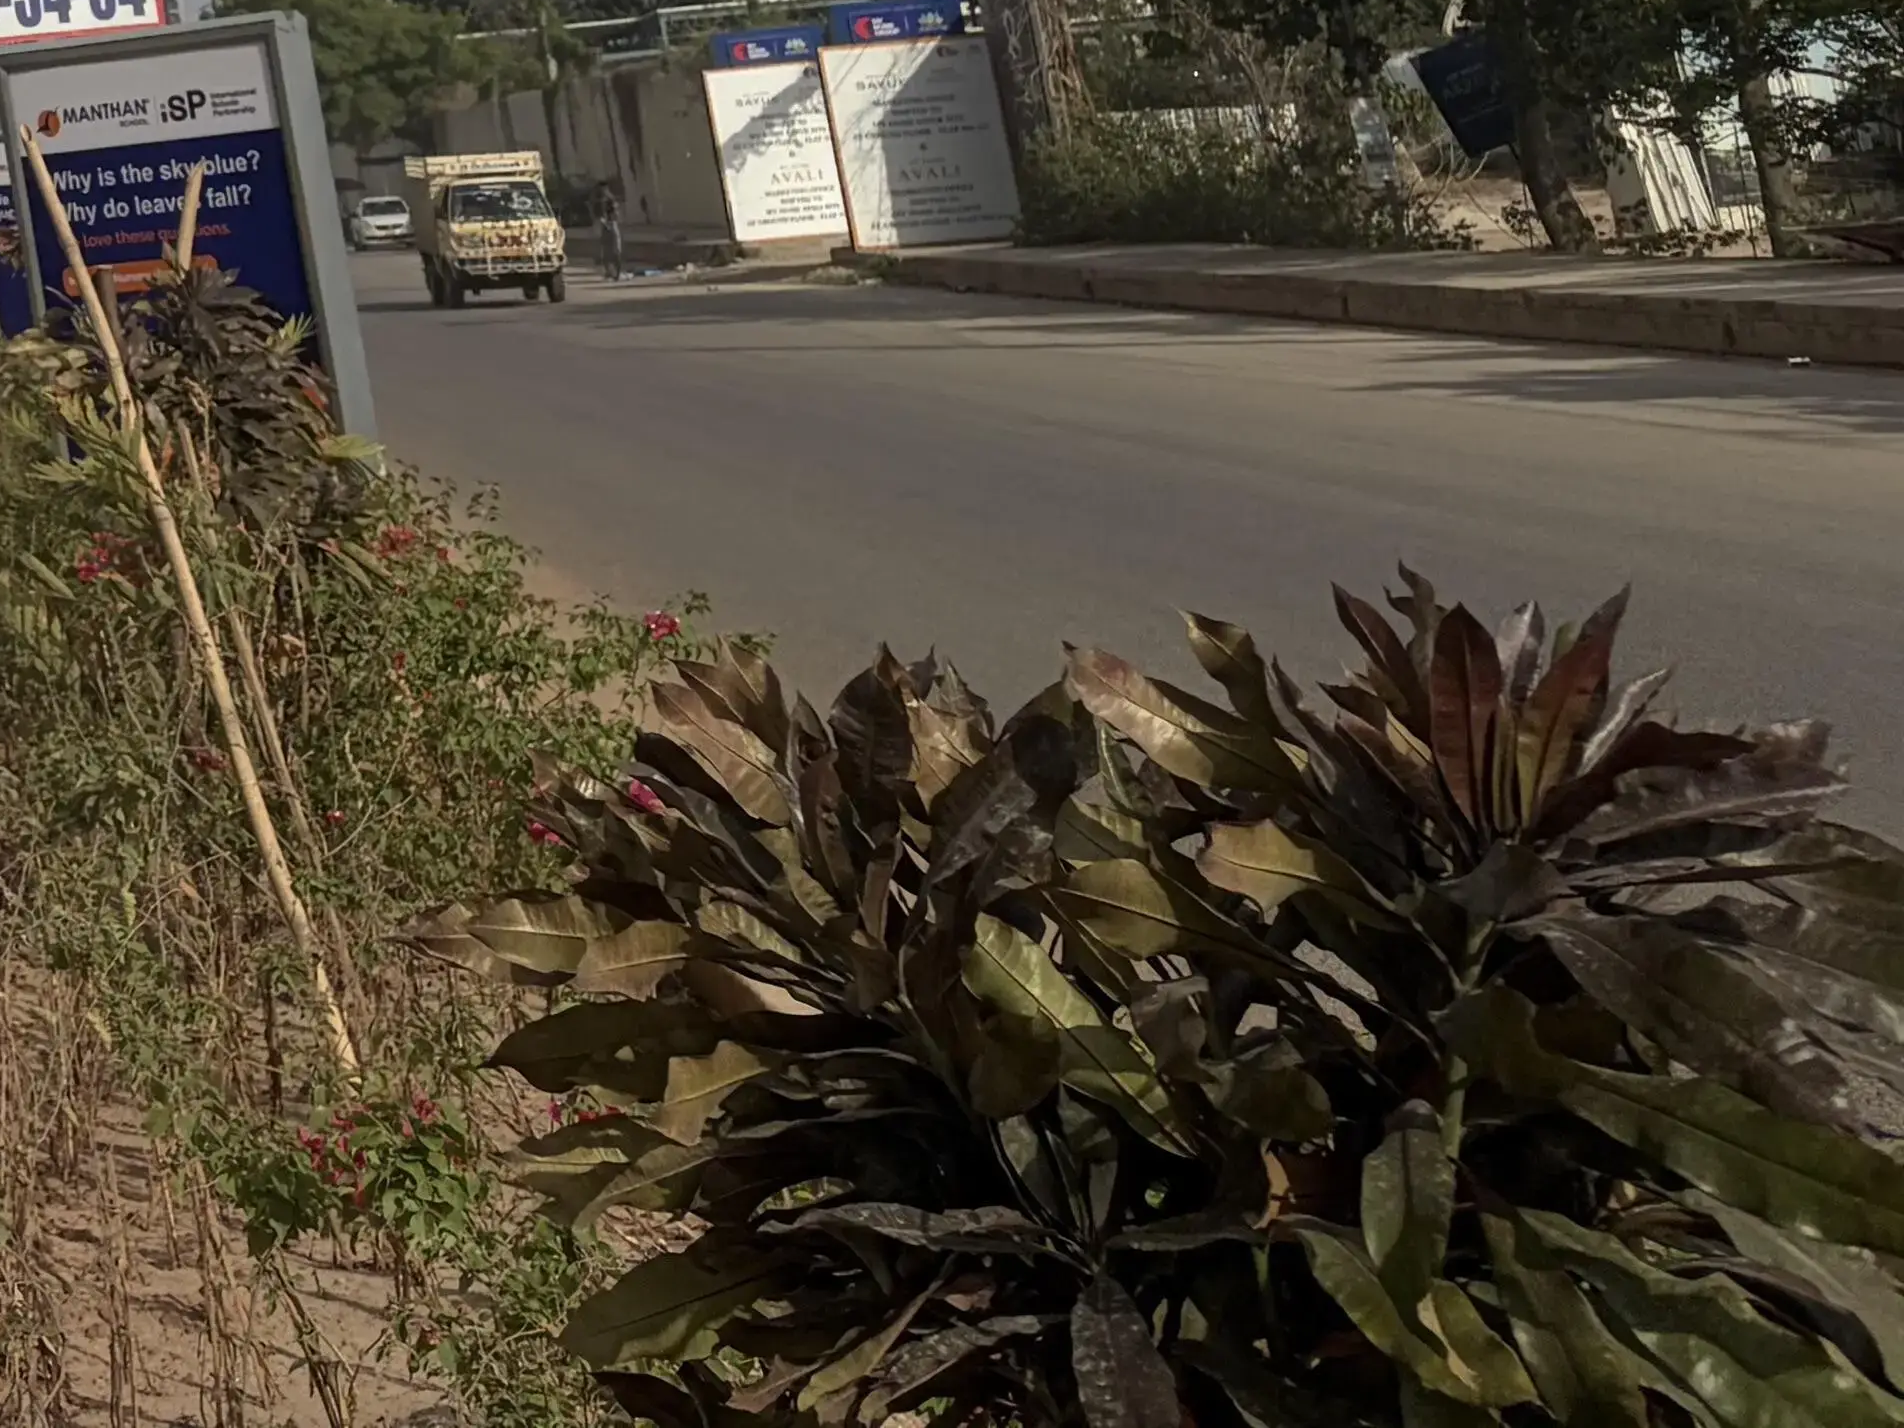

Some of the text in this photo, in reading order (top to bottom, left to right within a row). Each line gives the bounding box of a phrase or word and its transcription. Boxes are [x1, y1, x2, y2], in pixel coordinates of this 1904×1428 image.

[62, 98, 147, 125] MANTHAN
[53, 169, 92, 195] Why
[97, 166, 117, 187] is
[120, 162, 153, 185] the
[201, 149, 261, 176] blue?
[770, 167, 824, 186] AVALI
[103, 197, 130, 219] do
[133, 192, 201, 216] leave
[205, 183, 252, 209] fall?
